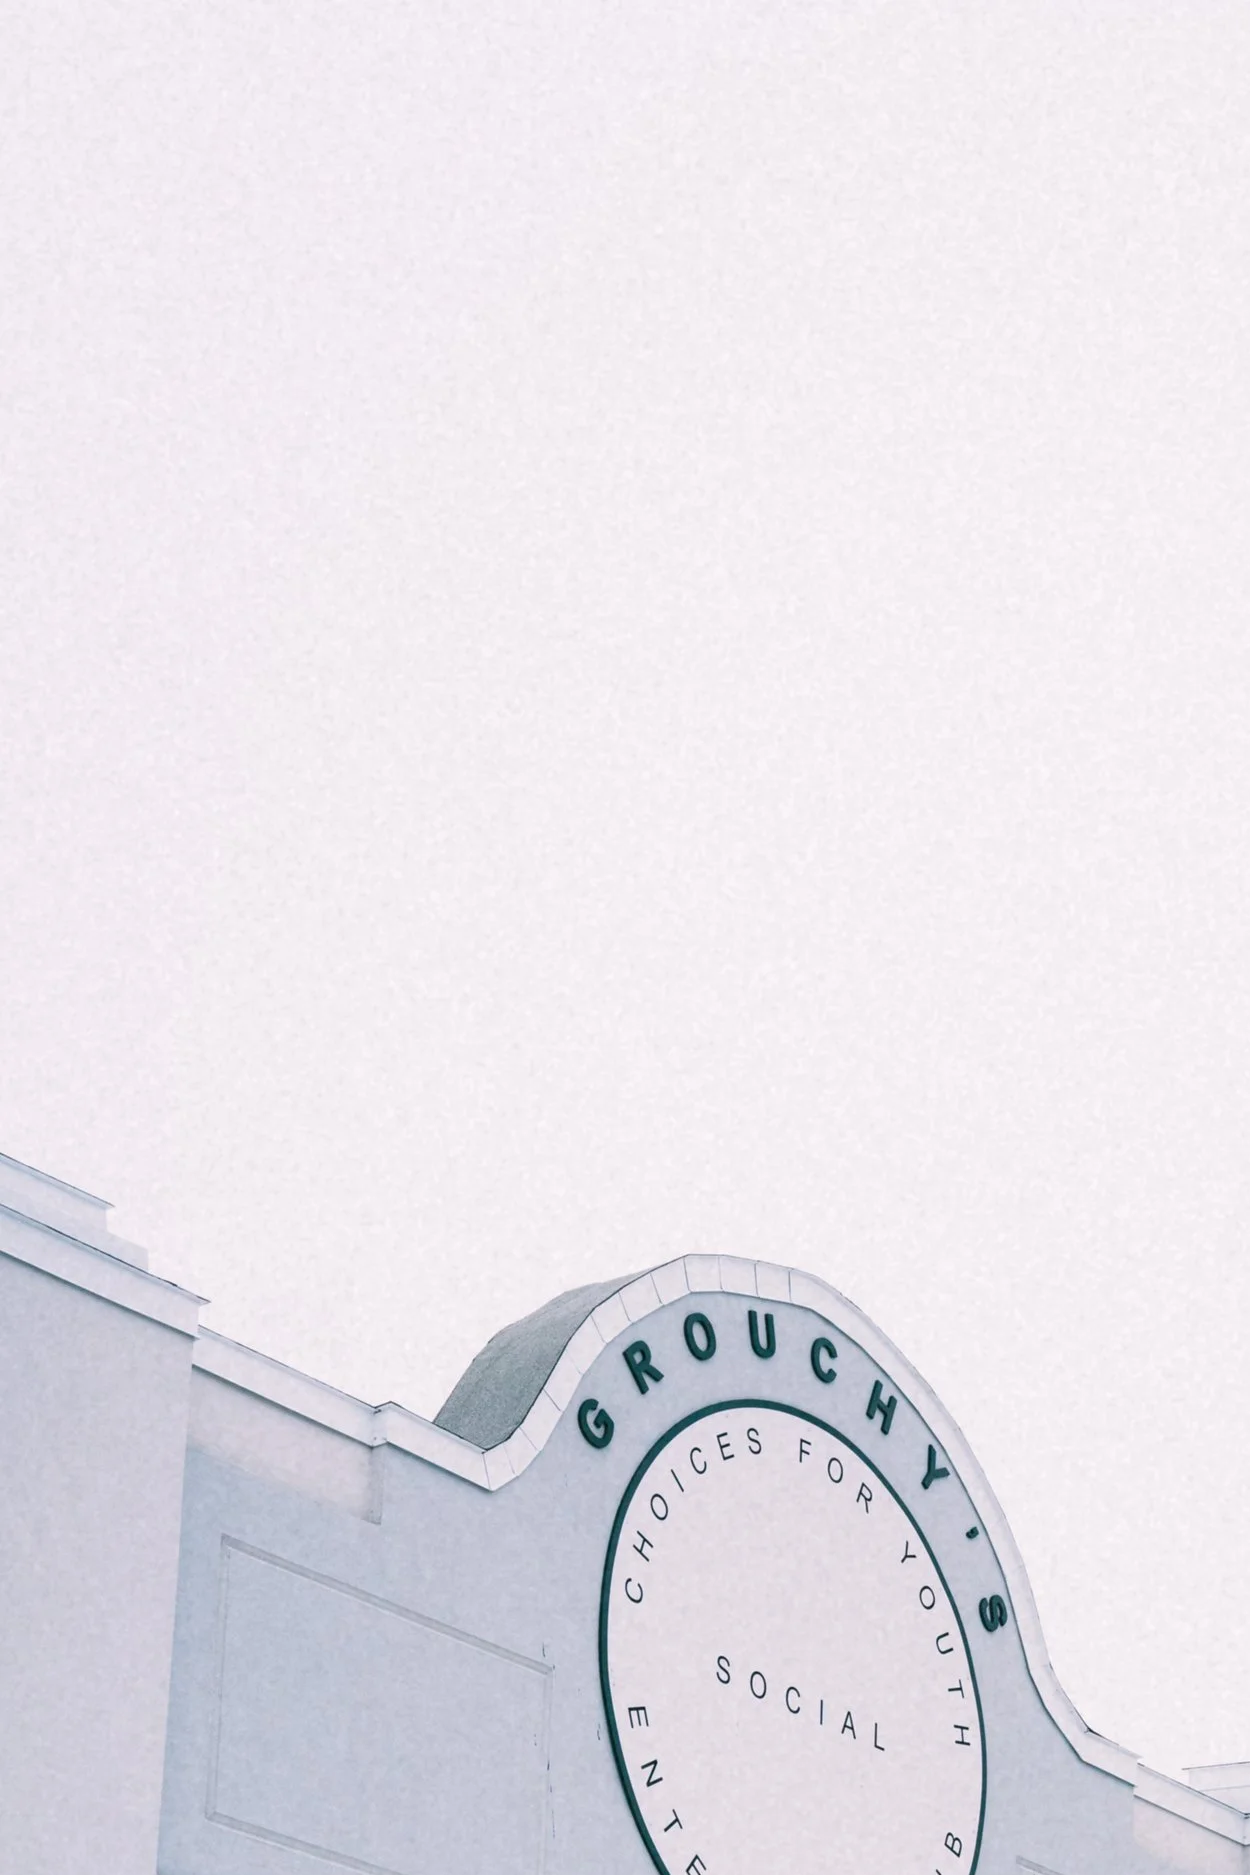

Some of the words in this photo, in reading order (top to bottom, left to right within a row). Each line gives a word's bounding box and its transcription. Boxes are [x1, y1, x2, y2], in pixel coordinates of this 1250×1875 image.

[577, 1311, 1008, 1632] GROUCHY'S
[624, 1427, 763, 1605] CHOICES
[798, 1439, 874, 1513] FOR
[901, 1540, 971, 1748] YOUTH
[716, 1655, 886, 1752] SOCIAL
